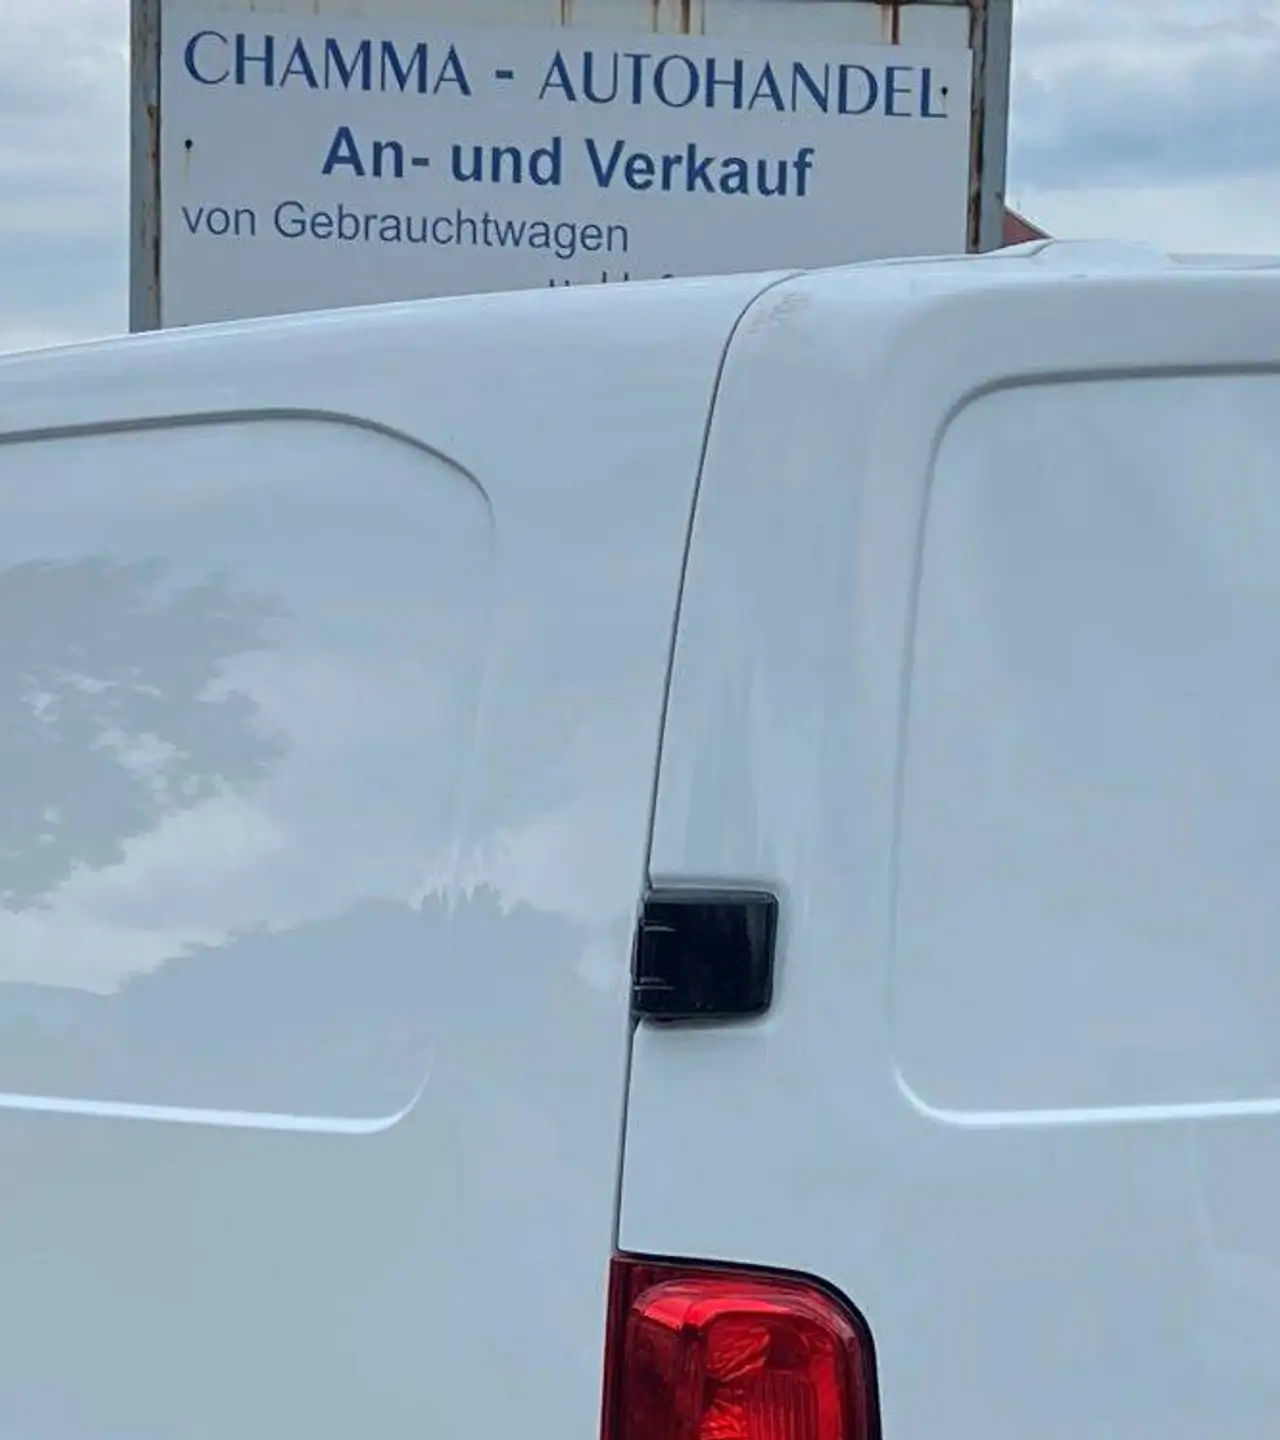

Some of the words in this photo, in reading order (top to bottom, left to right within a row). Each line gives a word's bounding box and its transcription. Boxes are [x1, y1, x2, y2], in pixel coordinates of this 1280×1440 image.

[184, 31, 472, 96] CHAMMA
[538, 49, 948, 118] AUTOHANDEL
[322, 126, 429, 178] An-
[451, 137, 561, 186] und
[584, 138, 814, 197] Verkauf
[182, 206, 256, 237] von
[274, 201, 629, 260] Gebrauchtwagen
